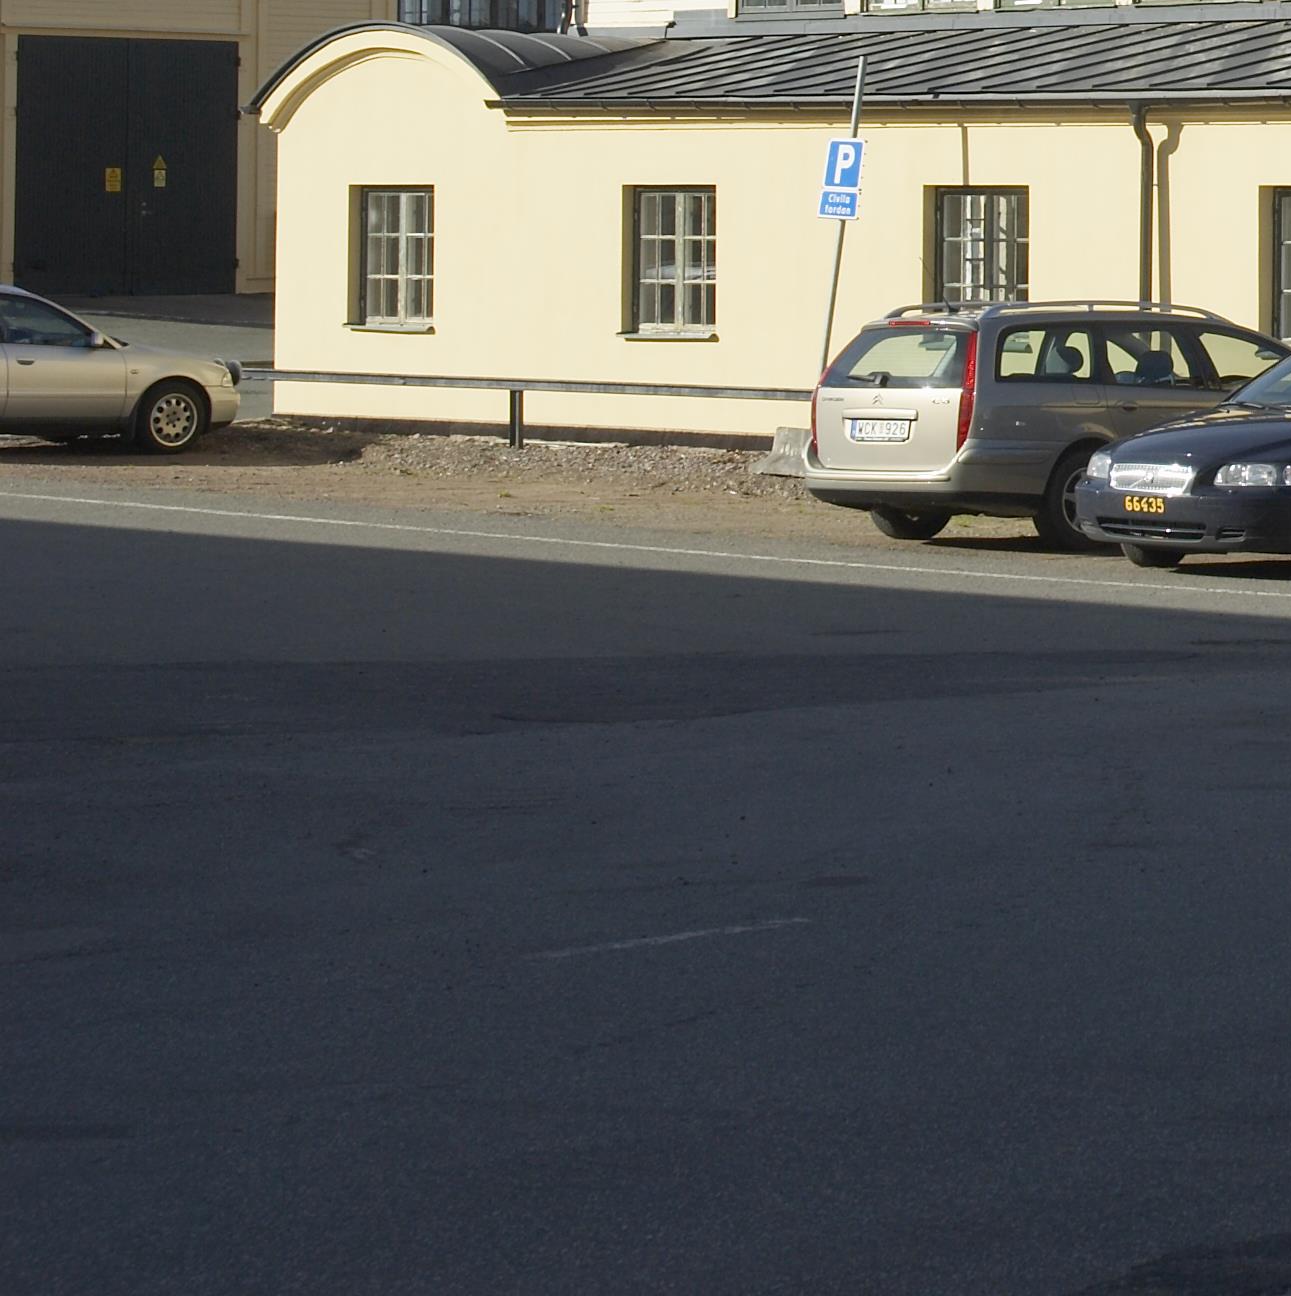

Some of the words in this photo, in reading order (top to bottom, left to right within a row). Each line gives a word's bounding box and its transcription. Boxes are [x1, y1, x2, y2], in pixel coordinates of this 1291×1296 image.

[834, 144, 855, 184] P
[858, 422, 877, 435] WCK
[885, 422, 907, 436] 926
[1125, 496, 1164, 513] 66435
